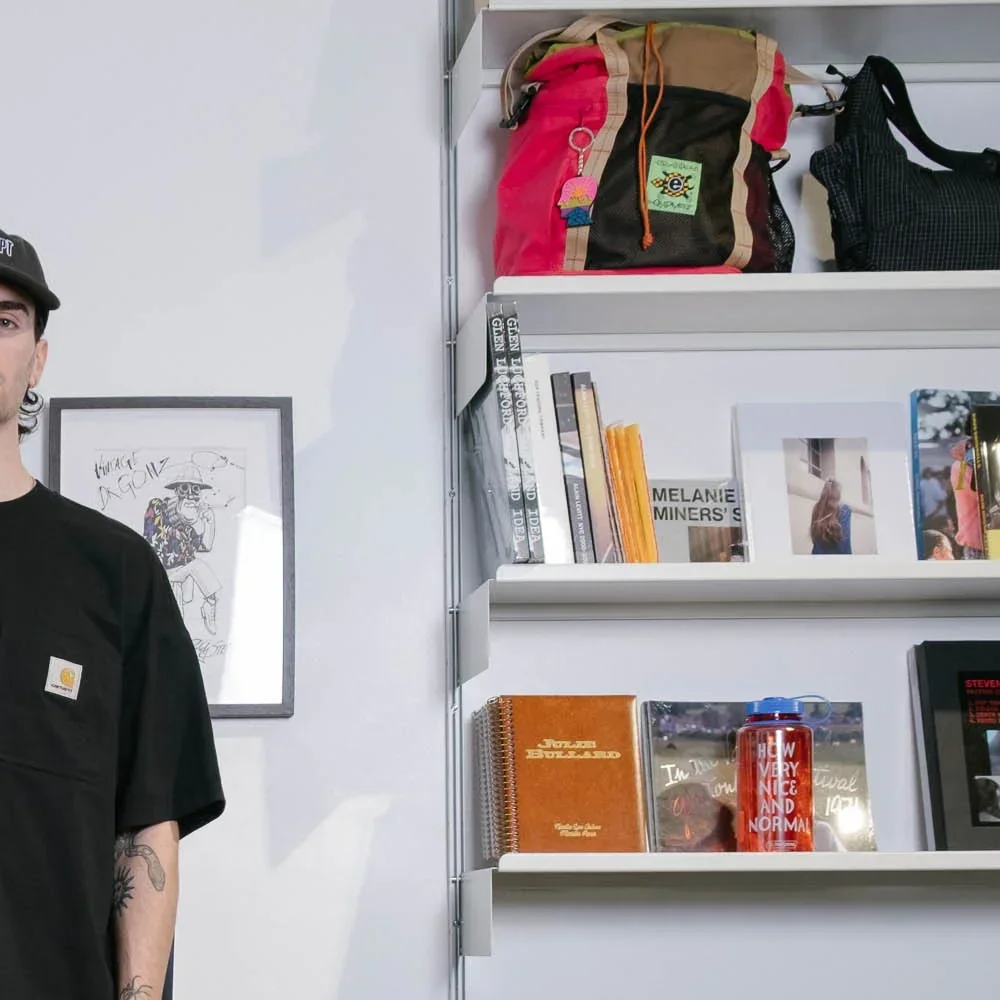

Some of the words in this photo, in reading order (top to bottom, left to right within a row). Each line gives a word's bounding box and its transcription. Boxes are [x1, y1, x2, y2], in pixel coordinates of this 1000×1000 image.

[652, 487, 736, 503] MELANIE
[653, 506, 728, 522] MINERS'
[758, 742, 796, 758] HOW
[759, 761, 800, 778] VERY
[759, 780, 799, 796] NICE
[760, 798, 796, 815] AND
[749, 817, 811, 833] NORMAL
